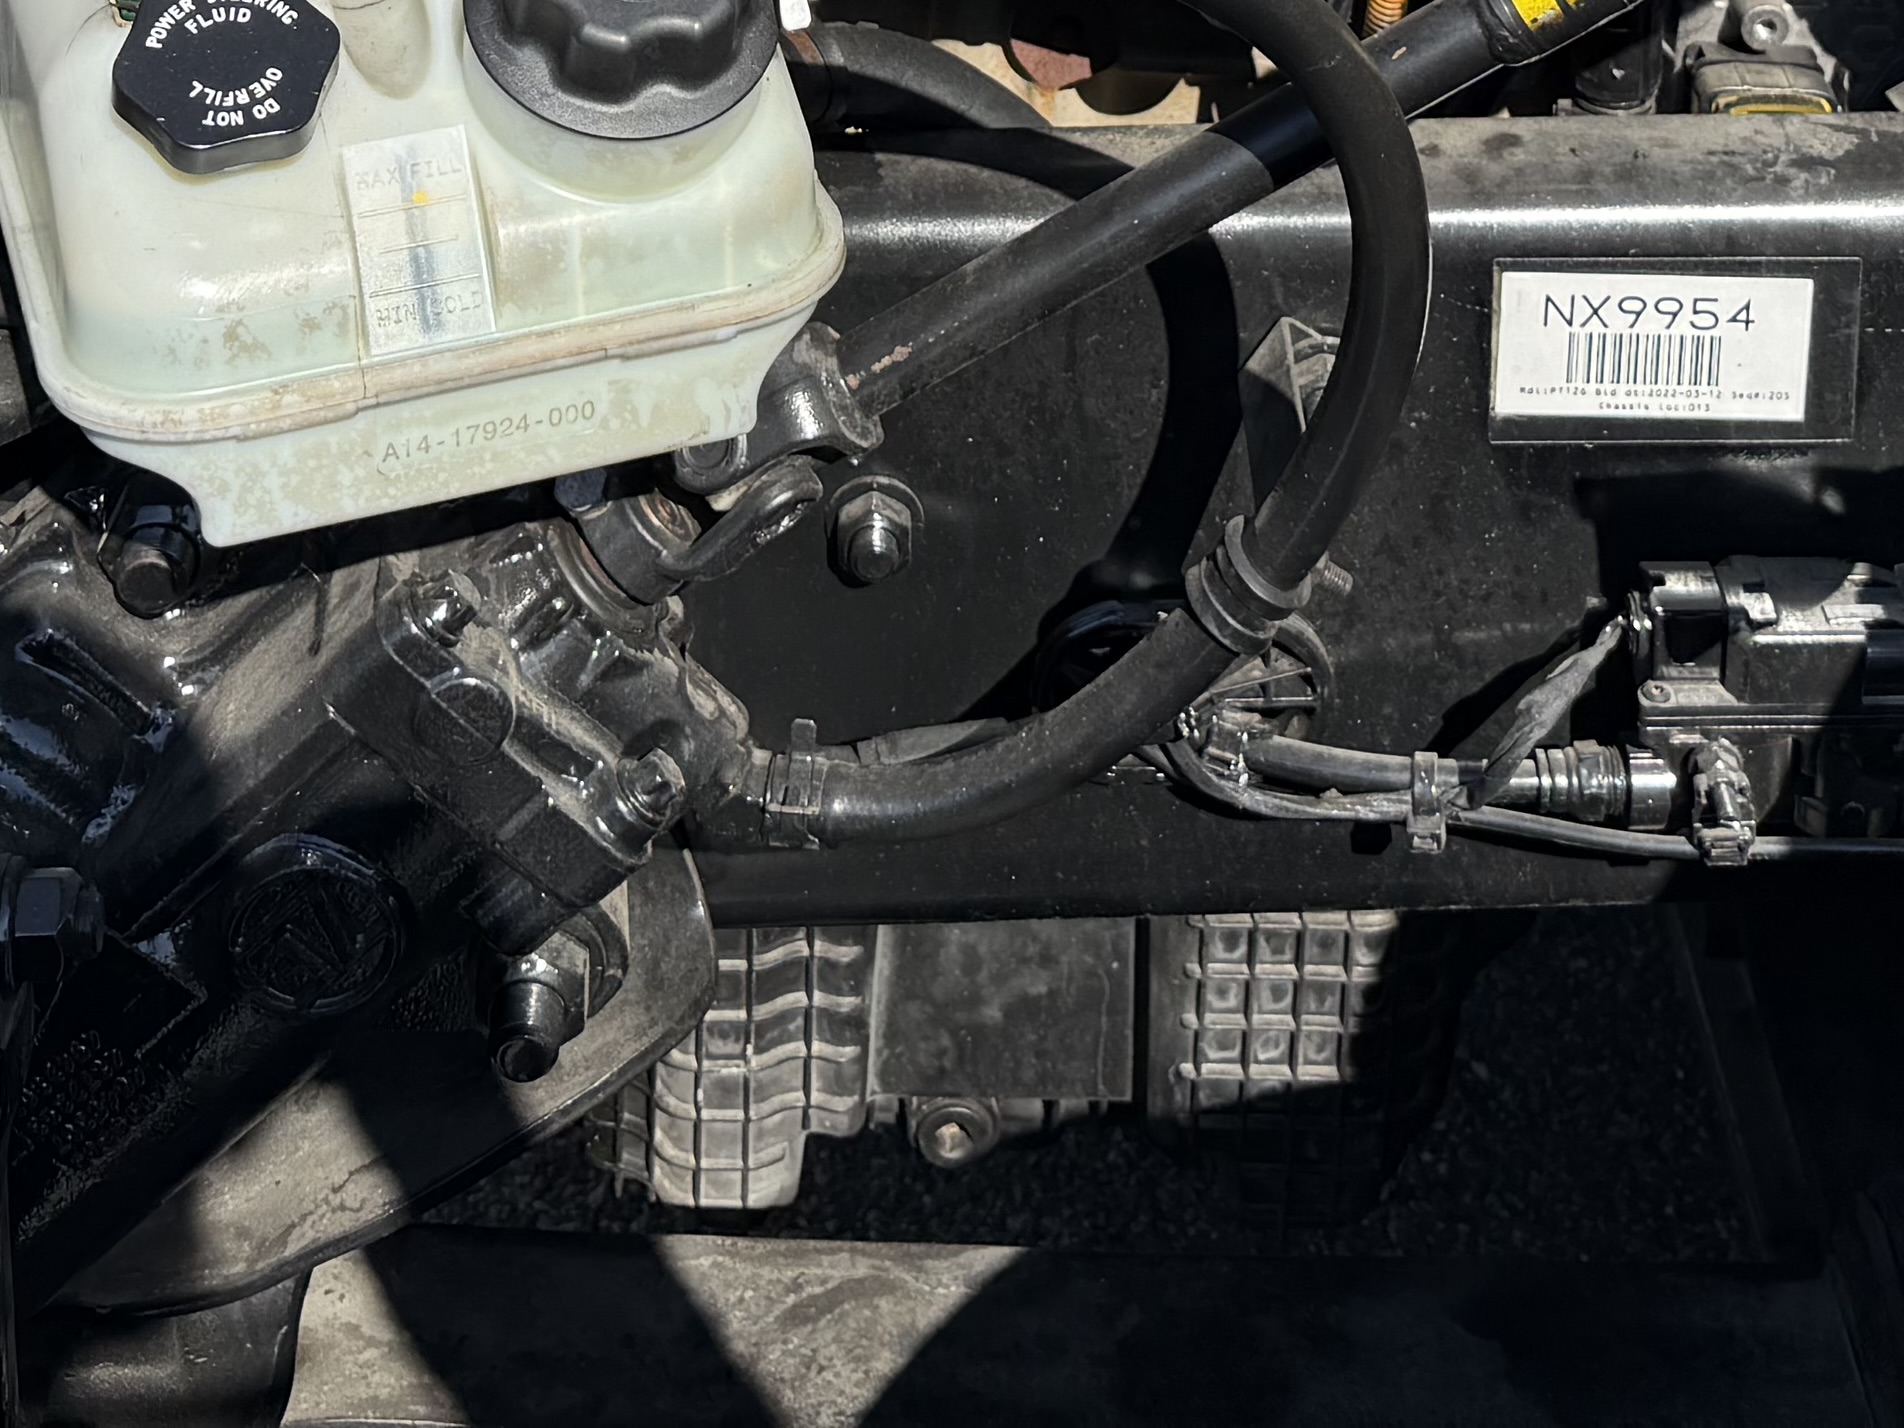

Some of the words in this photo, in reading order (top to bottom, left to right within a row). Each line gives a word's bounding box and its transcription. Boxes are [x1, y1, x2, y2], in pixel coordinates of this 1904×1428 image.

[184, 6, 252, 35] FLUID
[188, 66, 284, 108] OVERFILL
[201, 109, 245, 127] NOT
[251, 96, 282, 120] DO
[354, 166, 401, 191] MAX
[409, 156, 465, 181] FILL
[373, 301, 418, 330] MIN
[1541, 292, 1757, 332] NX9954
[1598, 401, 1652, 412] Chassis
[380, 397, 598, 465] A14-17924-000
